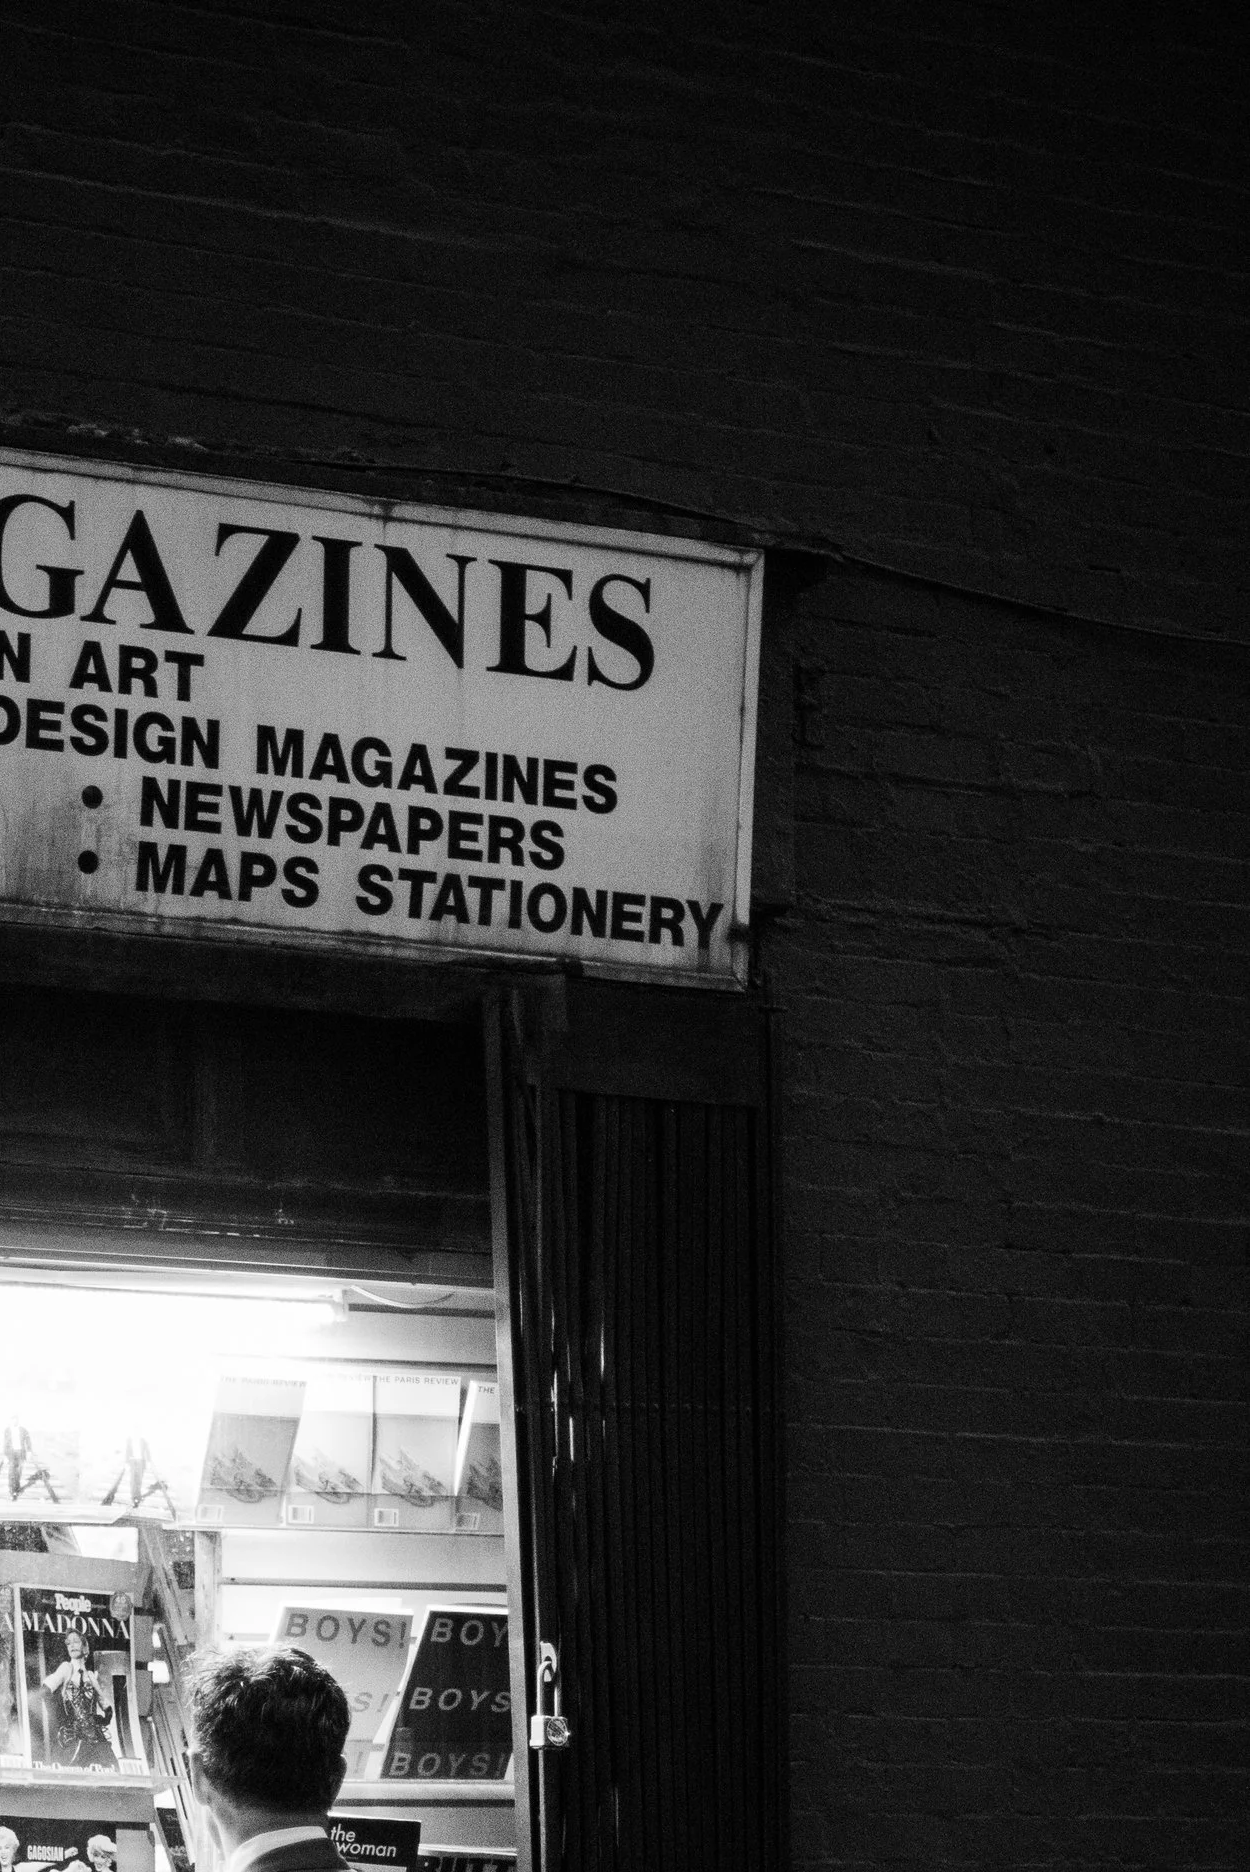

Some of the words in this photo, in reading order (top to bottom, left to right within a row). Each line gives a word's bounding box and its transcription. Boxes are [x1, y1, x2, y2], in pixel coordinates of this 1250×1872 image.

[69, 640, 206, 703] ART
[256, 724, 619, 815] MAGAZINES
[139, 775, 565, 871] NEWSPAPERS
[136, 841, 320, 908] MAPS
[355, 863, 724, 950] STATIONERY
[394, 1376, 421, 1385] PARIS
[423, 1377, 459, 1386] REVIEW
[477, 1386, 496, 1395] THE
[54, 1592, 92, 1616] People
[22, 1611, 131, 1639] MADONNA
[284, 1612, 407, 1648] BOYS!
[408, 1686, 510, 1713] BOYS
[388, 1751, 506, 1778] BOYS!
[330, 1823, 356, 1842] the
[27, 1845, 64, 1862] GAGOSIAN
[336, 1841, 398, 1858] woman
